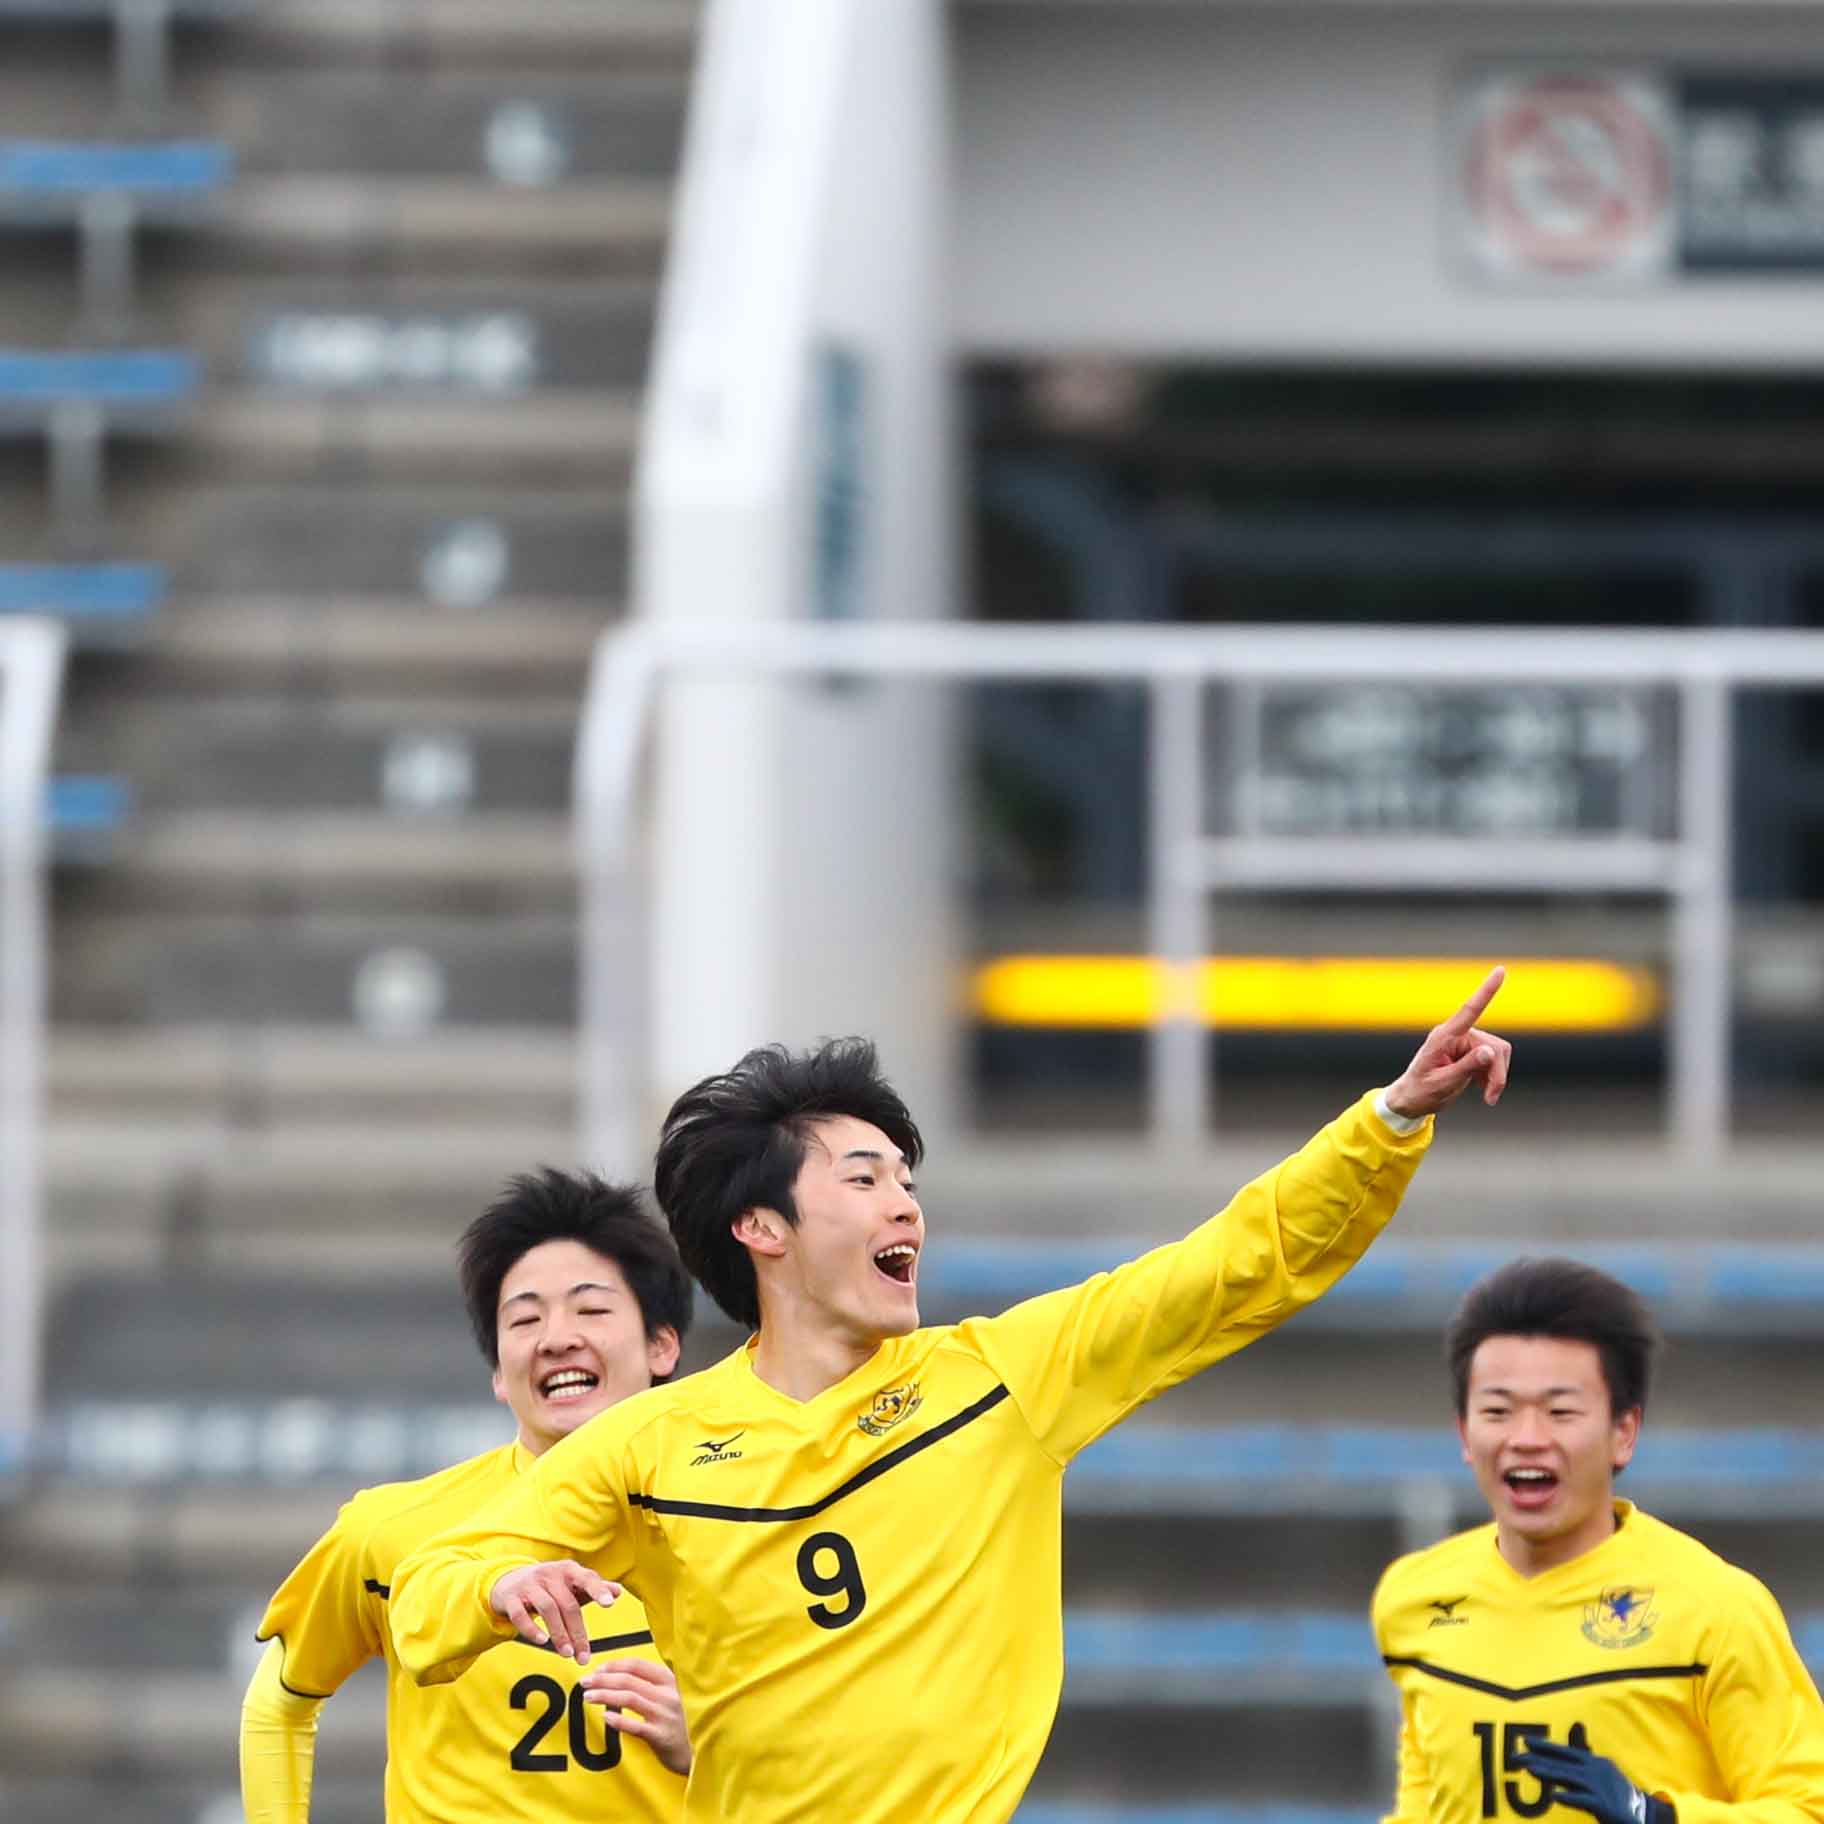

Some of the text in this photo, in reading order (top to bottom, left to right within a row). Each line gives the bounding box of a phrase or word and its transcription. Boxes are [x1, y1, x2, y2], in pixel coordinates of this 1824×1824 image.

[795, 1531, 867, 1630] 9
[509, 1673, 623, 1773] 20
[1473, 1722, 1553, 1820] 15
